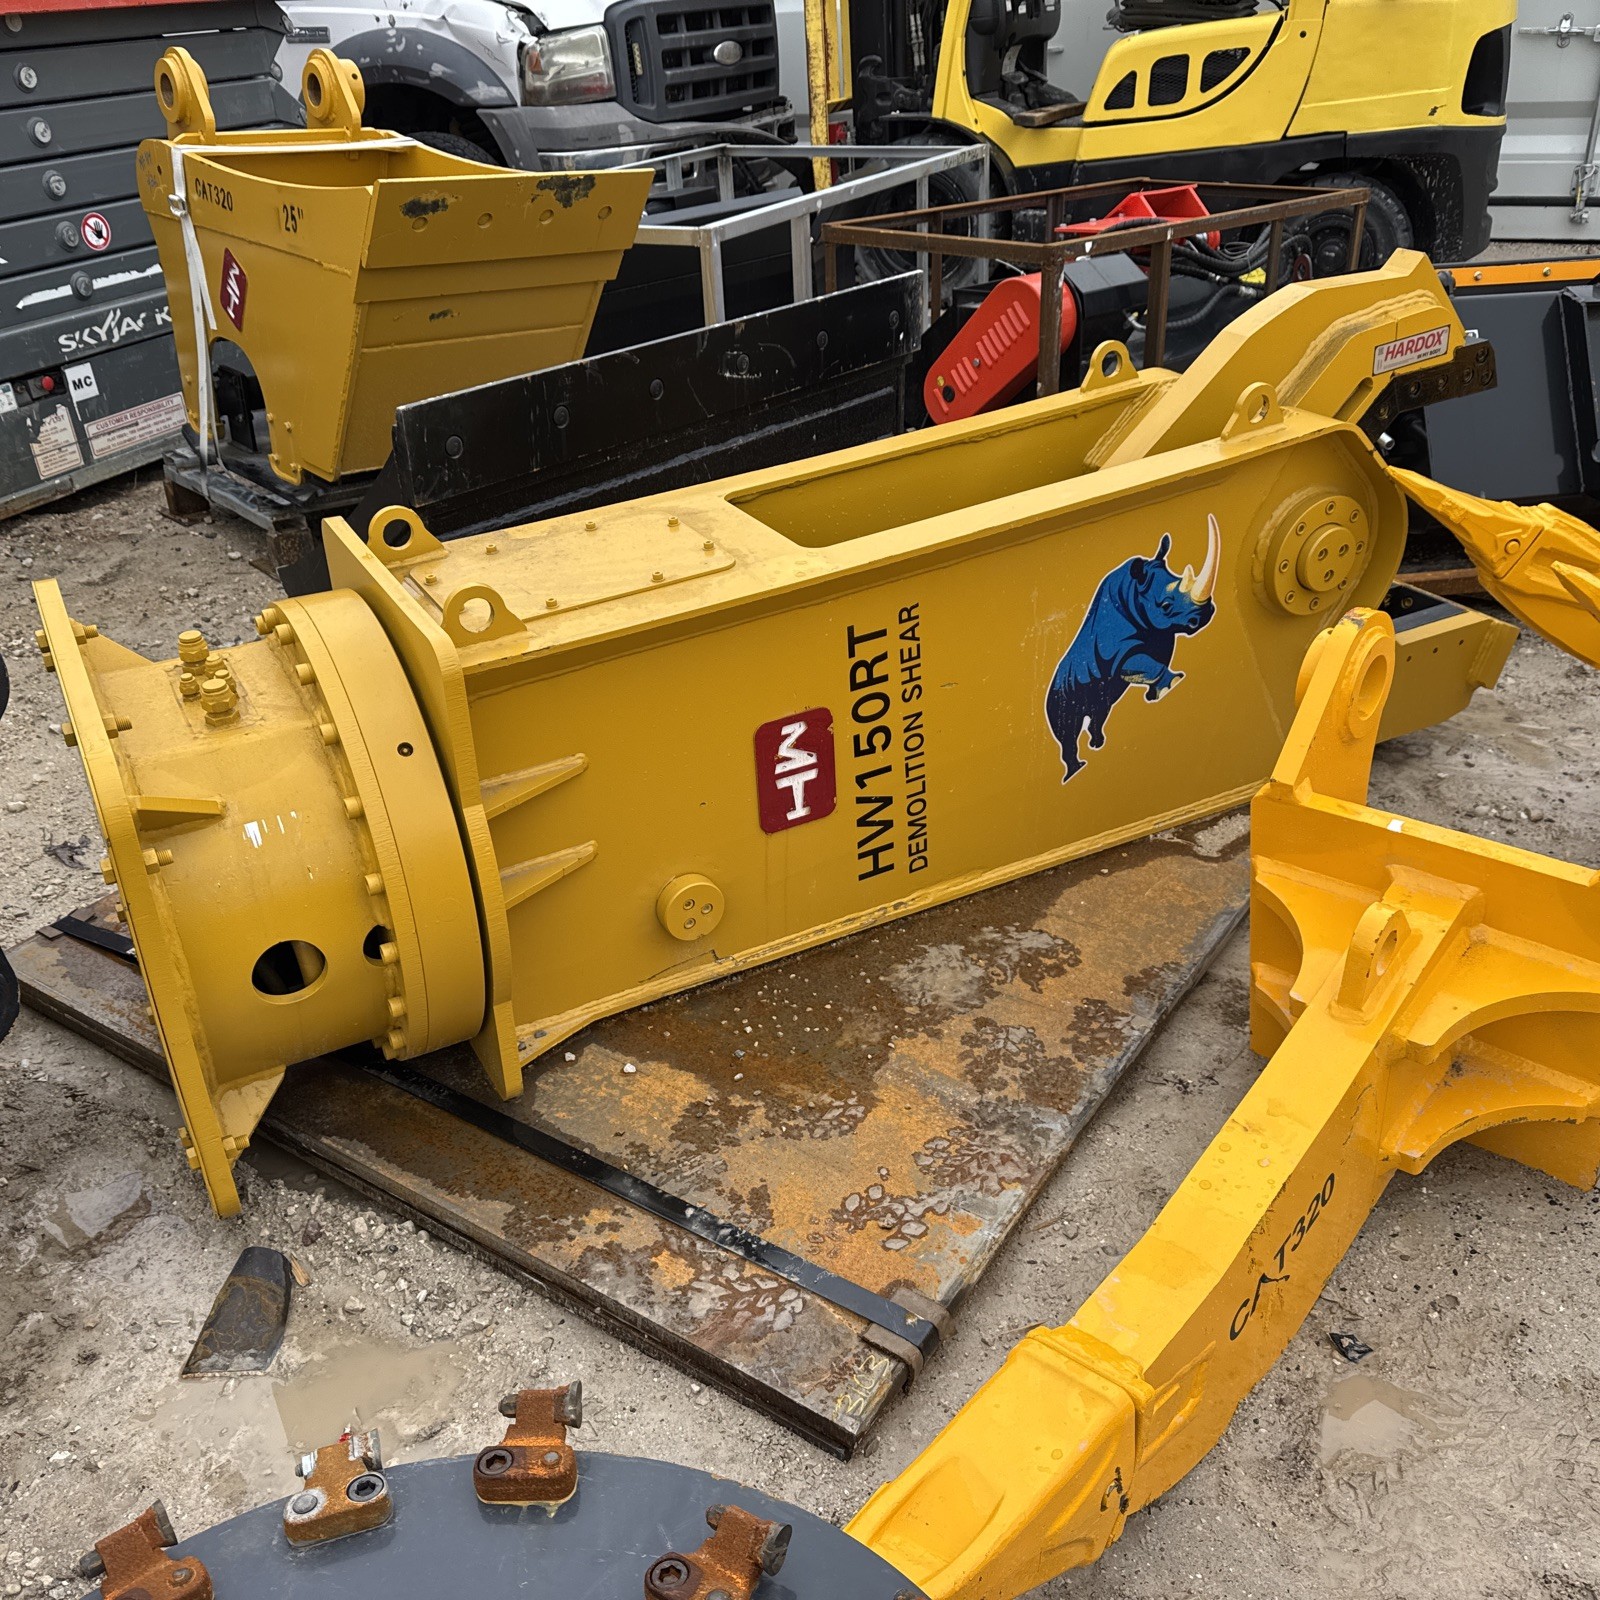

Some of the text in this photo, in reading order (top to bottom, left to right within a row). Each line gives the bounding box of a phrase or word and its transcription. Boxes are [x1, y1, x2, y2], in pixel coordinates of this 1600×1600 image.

[194, 177, 234, 212] CAT320
[71, 375, 93, 391] MC
[95, 413, 129, 431] CUSTOMER
[129, 398, 174, 419] RESPONSIBILITY
[847, 624, 895, 882] HW150RT
[898, 602, 929, 874] DEMOLITION SHEAR
[1229, 1172, 1335, 1341] CAT320
